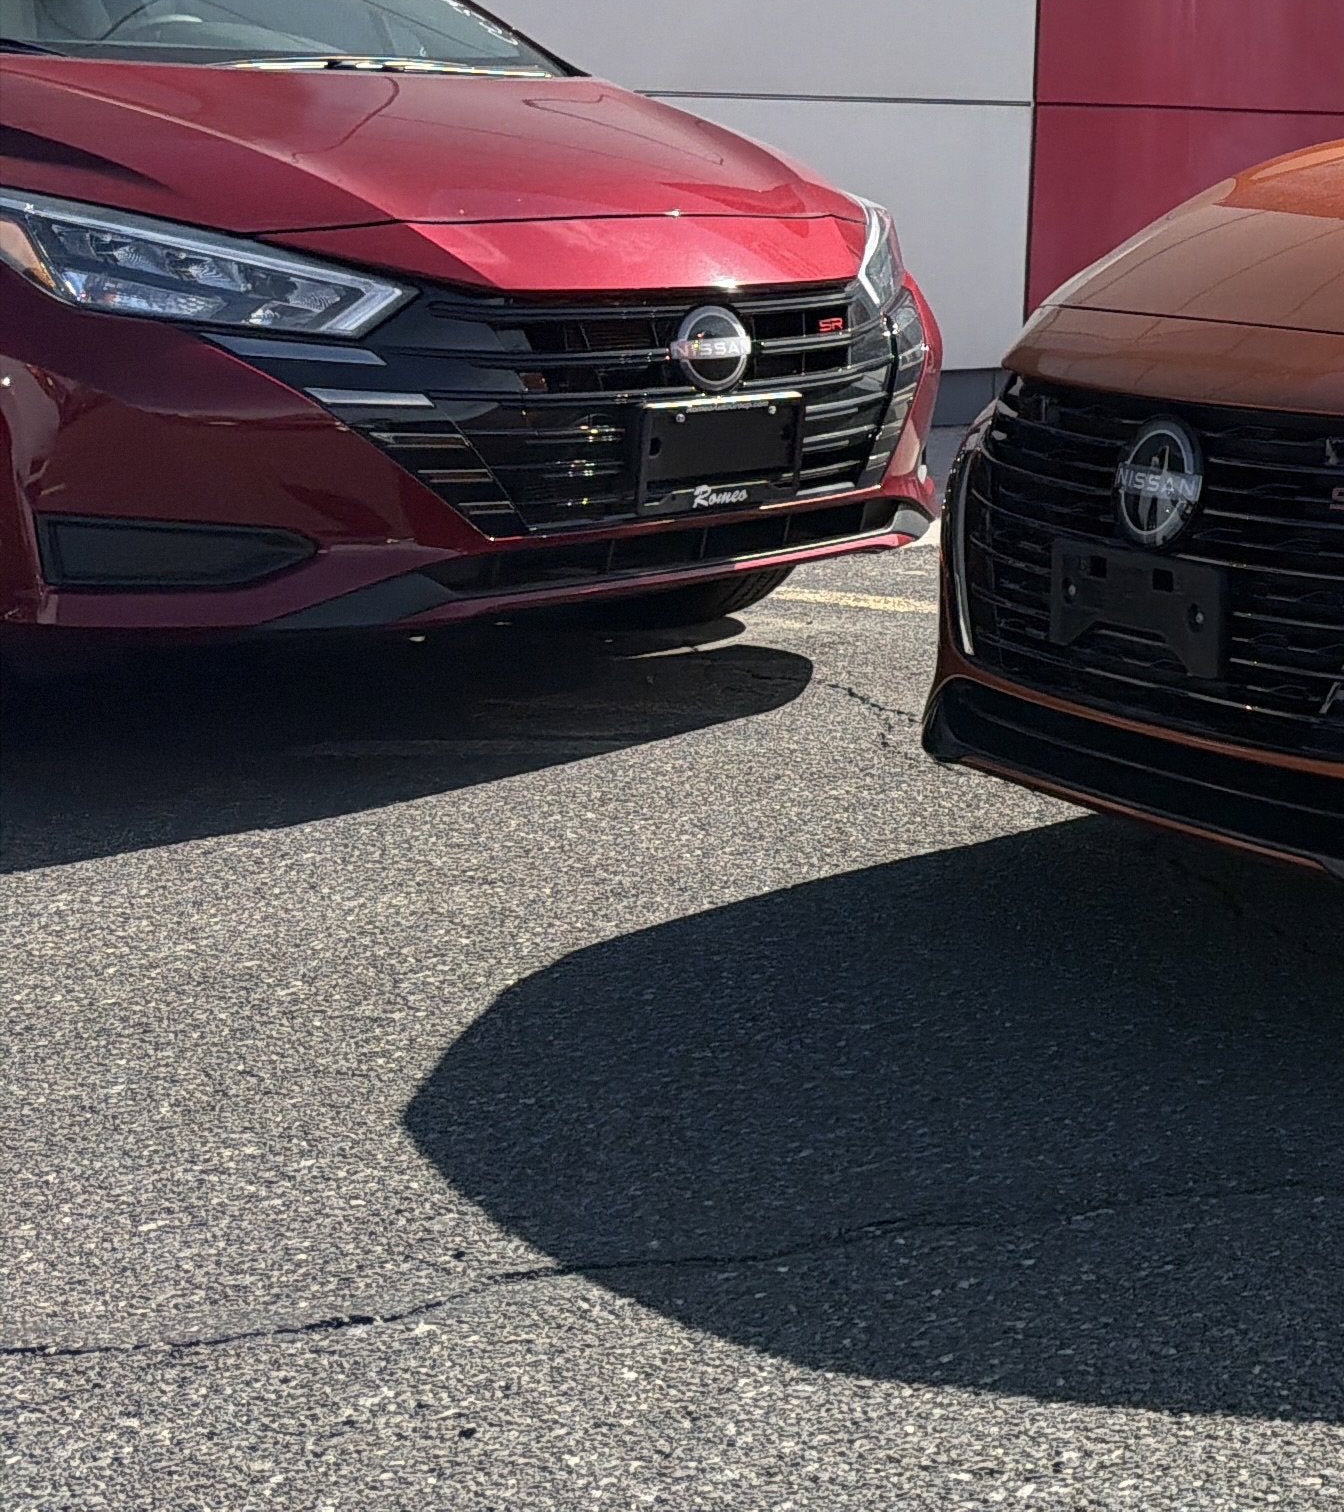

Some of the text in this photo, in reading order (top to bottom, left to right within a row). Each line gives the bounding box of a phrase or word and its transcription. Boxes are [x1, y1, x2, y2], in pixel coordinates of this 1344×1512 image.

[818, 317, 844, 333] SR
[675, 337, 750, 358] NISSAN
[1115, 467, 1198, 500] NISSAN
[692, 484, 749, 509] Romeo
